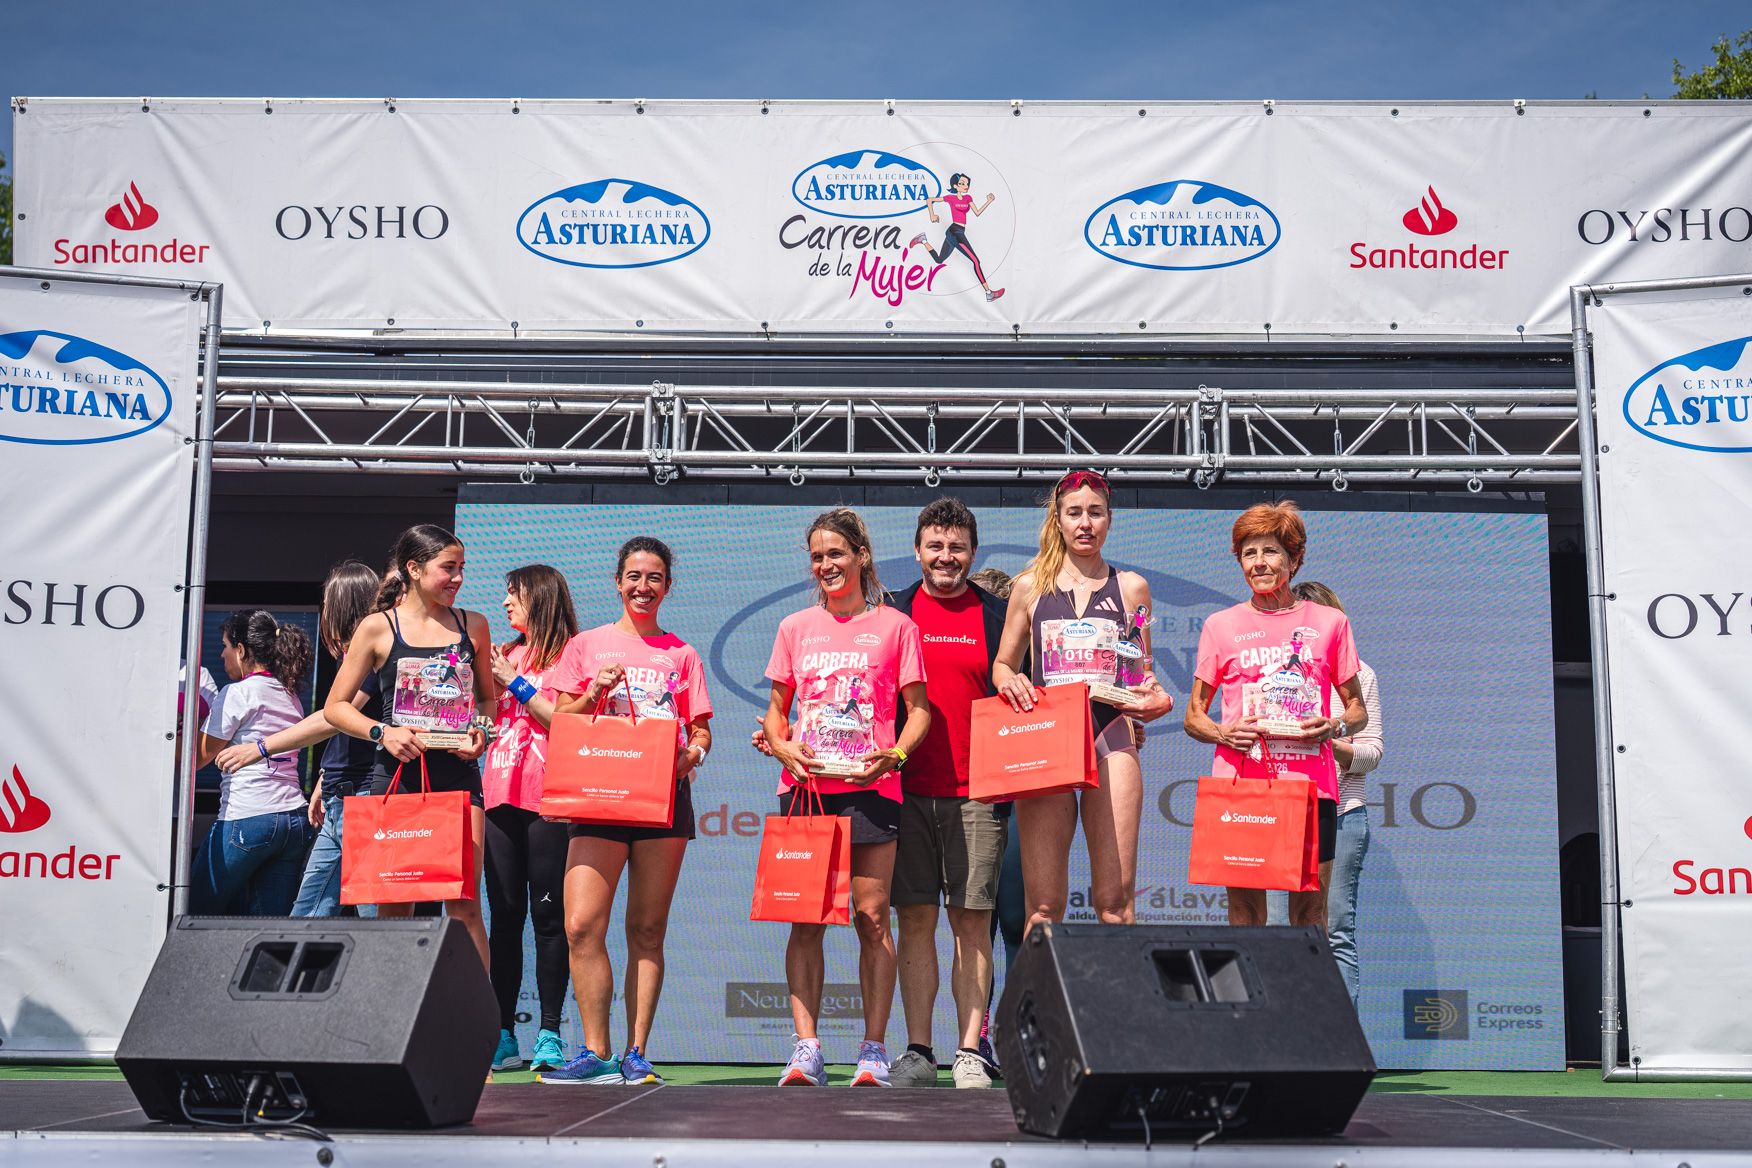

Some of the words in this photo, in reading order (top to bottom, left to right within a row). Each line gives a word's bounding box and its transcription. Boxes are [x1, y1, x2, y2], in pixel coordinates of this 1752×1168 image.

[826, 173, 874, 181] CENTRAL
[878, 173, 926, 181] LECHERA
[803, 175, 930, 201] ASTURIANA
[561, 210, 623, 219] CENTRAL
[627, 210, 691, 219] LECHERA
[1130, 211, 1191, 220] CENTRAL
[1198, 211, 1261, 220] LECHERA
[276, 205, 449, 241] OYSHO
[530, 212, 697, 246] ASTURIANA
[1098, 213, 1266, 248] ASTURIANA
[1578, 207, 1752, 245] OYSHO
[779, 214, 902, 250] Carrera
[54, 239, 209, 265] Santander
[1349, 242, 1510, 270] Santander
[808, 251, 831, 277] de
[836, 251, 852, 277] la
[849, 247, 947, 307] Mujer
[63, 372, 145, 387] LECHERA
[1644, 383, 1752, 426] ASTU
[0, 580, 145, 630] SHO
[1647, 592, 1752, 639] OY
[1066, 627, 1095, 635] ASTURIANA
[1234, 631, 1266, 643] OYSHO
[801, 635, 831, 646] OYSHO
[923, 633, 977, 645] Santander
[595, 651, 626, 661] OYSHO
[1065, 649, 1095, 661] 016
[1115, 645, 1140, 657] ASTURIANA
[1240, 646, 1314, 668] CARREA
[802, 651, 869, 671] CARRERA
[430, 688, 460, 696] ASTURIANA
[1261, 682, 1299, 694] Carrera
[1281, 695, 1319, 717] Mujer
[434, 706, 475, 729] Mujer
[818, 725, 854, 738] Carrera
[1010, 720, 1057, 735] Santander
[591, 747, 643, 758] Santander
[835, 739, 873, 760] Mujer
[1232, 813, 1277, 824] Santander
[386, 828, 434, 840] Santander
[0, 845, 121, 880] ander
[783, 850, 813, 860] Santander
[1150, 887, 1229, 909] álava
[737, 989, 863, 1015] Neugen
[1477, 1002, 1543, 1015] Correos
[1478, 1016, 1544, 1030] Express
